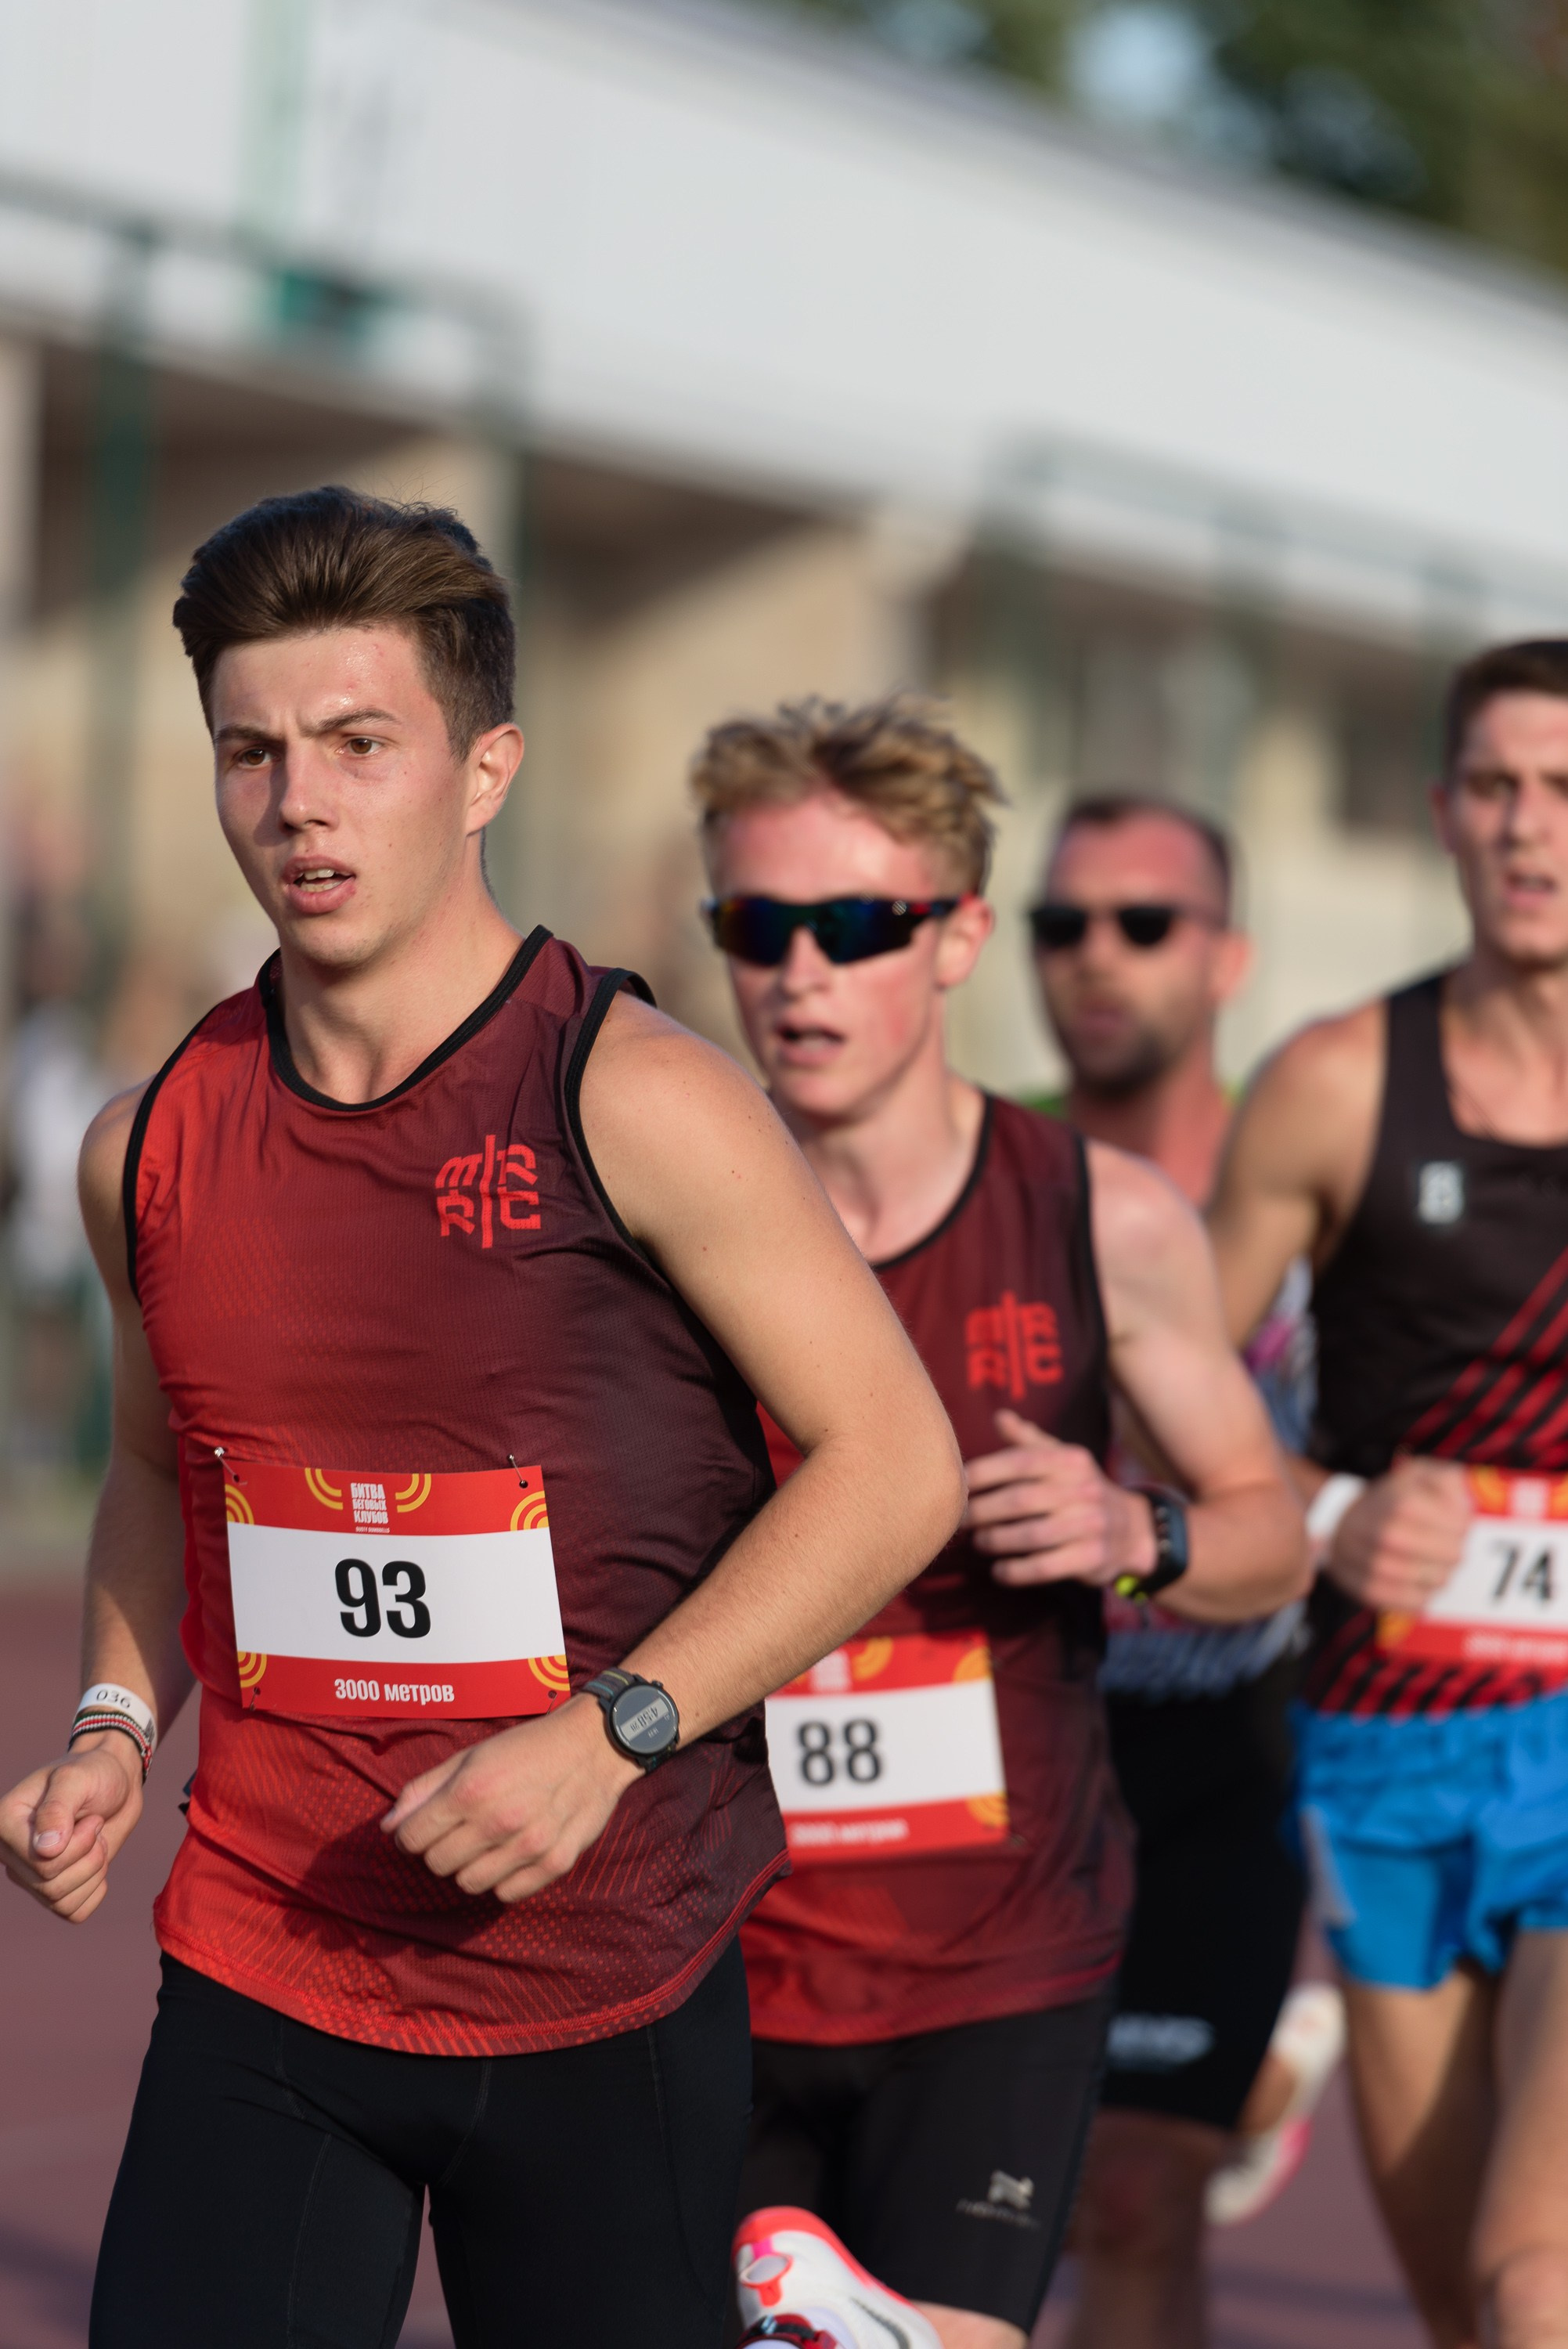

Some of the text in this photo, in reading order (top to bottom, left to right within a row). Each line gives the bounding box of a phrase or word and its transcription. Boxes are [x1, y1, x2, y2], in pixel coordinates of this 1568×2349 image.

[350, 1481, 386, 1499] БИТВА
[352, 1499, 387, 1511] БЕГОВЫХ
[353, 1510, 389, 1525] КЛУБОВ
[1489, 1539, 1553, 1603] 74
[334, 1558, 431, 1639] 93
[333, 1678, 455, 1705] 3000 метров
[795, 1718, 882, 1788] 88
